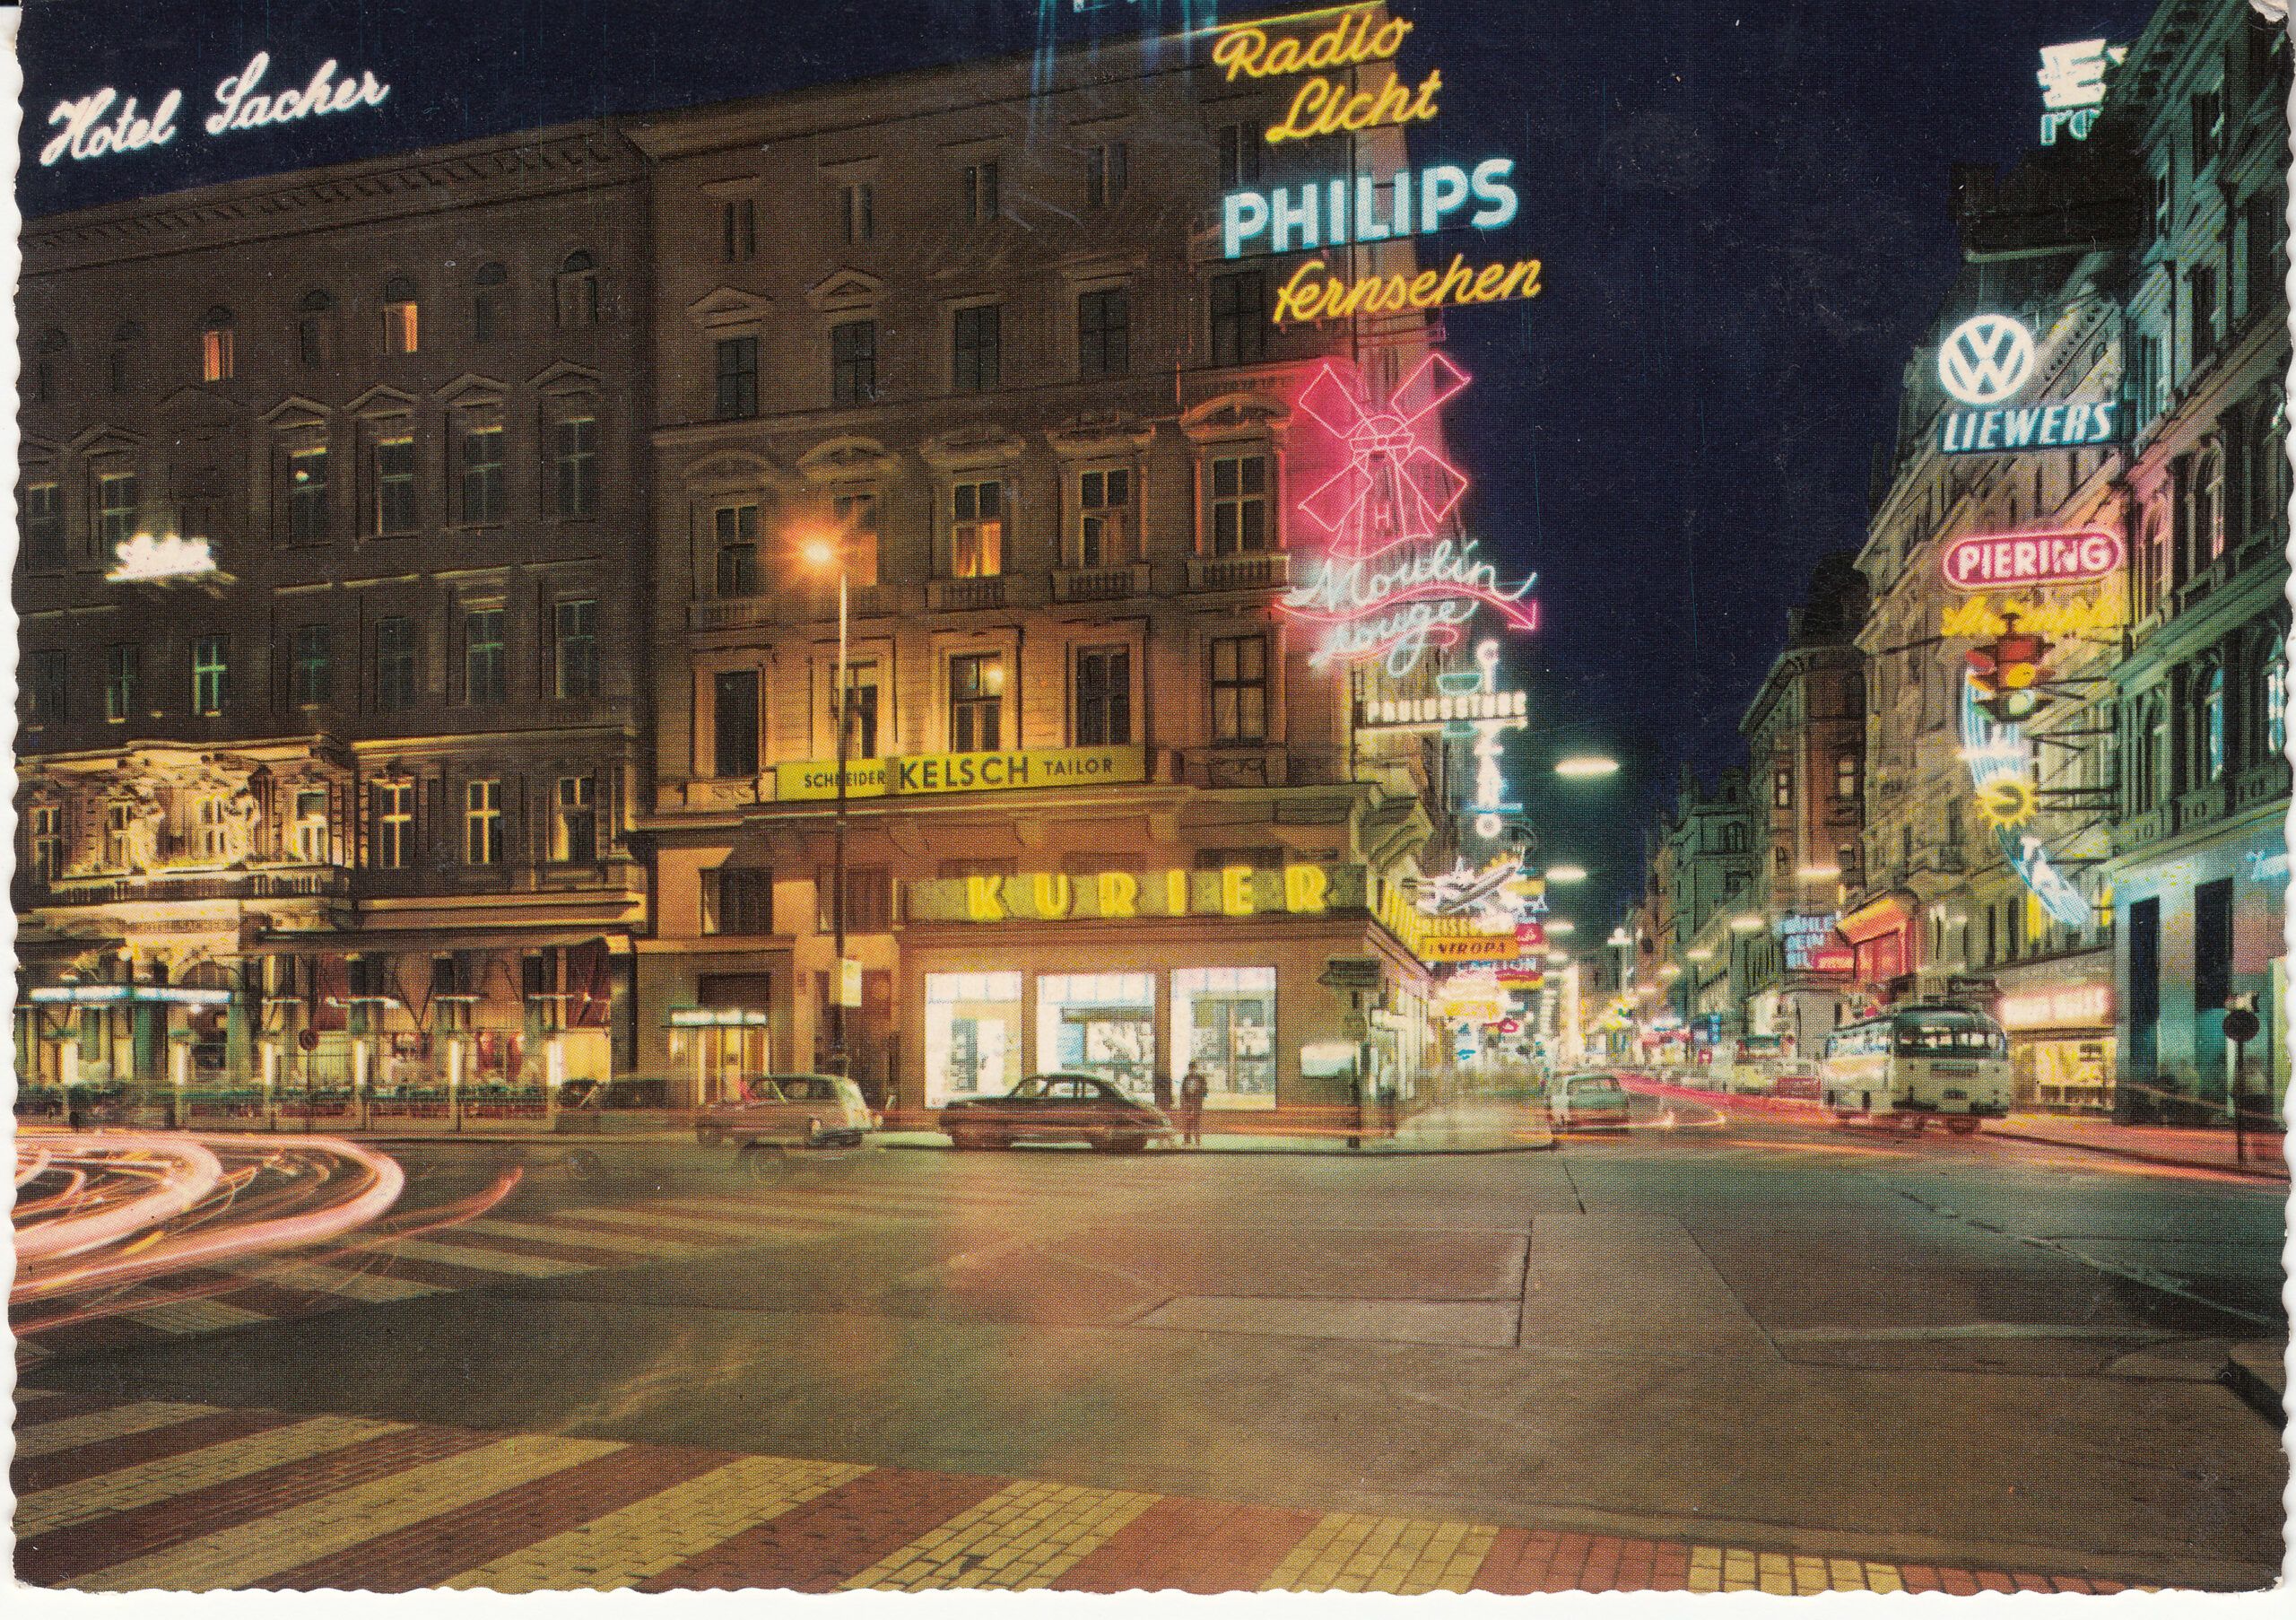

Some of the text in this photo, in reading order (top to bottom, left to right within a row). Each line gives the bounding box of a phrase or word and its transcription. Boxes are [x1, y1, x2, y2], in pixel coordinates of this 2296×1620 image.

[1213, 13, 1413, 82] Radio
[40, 50, 389, 166] Hotel Sacher
[1265, 69, 1442, 143] Licht
[1223, 158, 1518, 258] PHILIPS
[1943, 402, 2118, 453] LIEWERS
[1958, 536, 2110, 581] PIERING
[900, 756, 1029, 789] KELSCH
[1044, 758, 1112, 777] TAILOR
[968, 863, 1329, 922] KURIER
